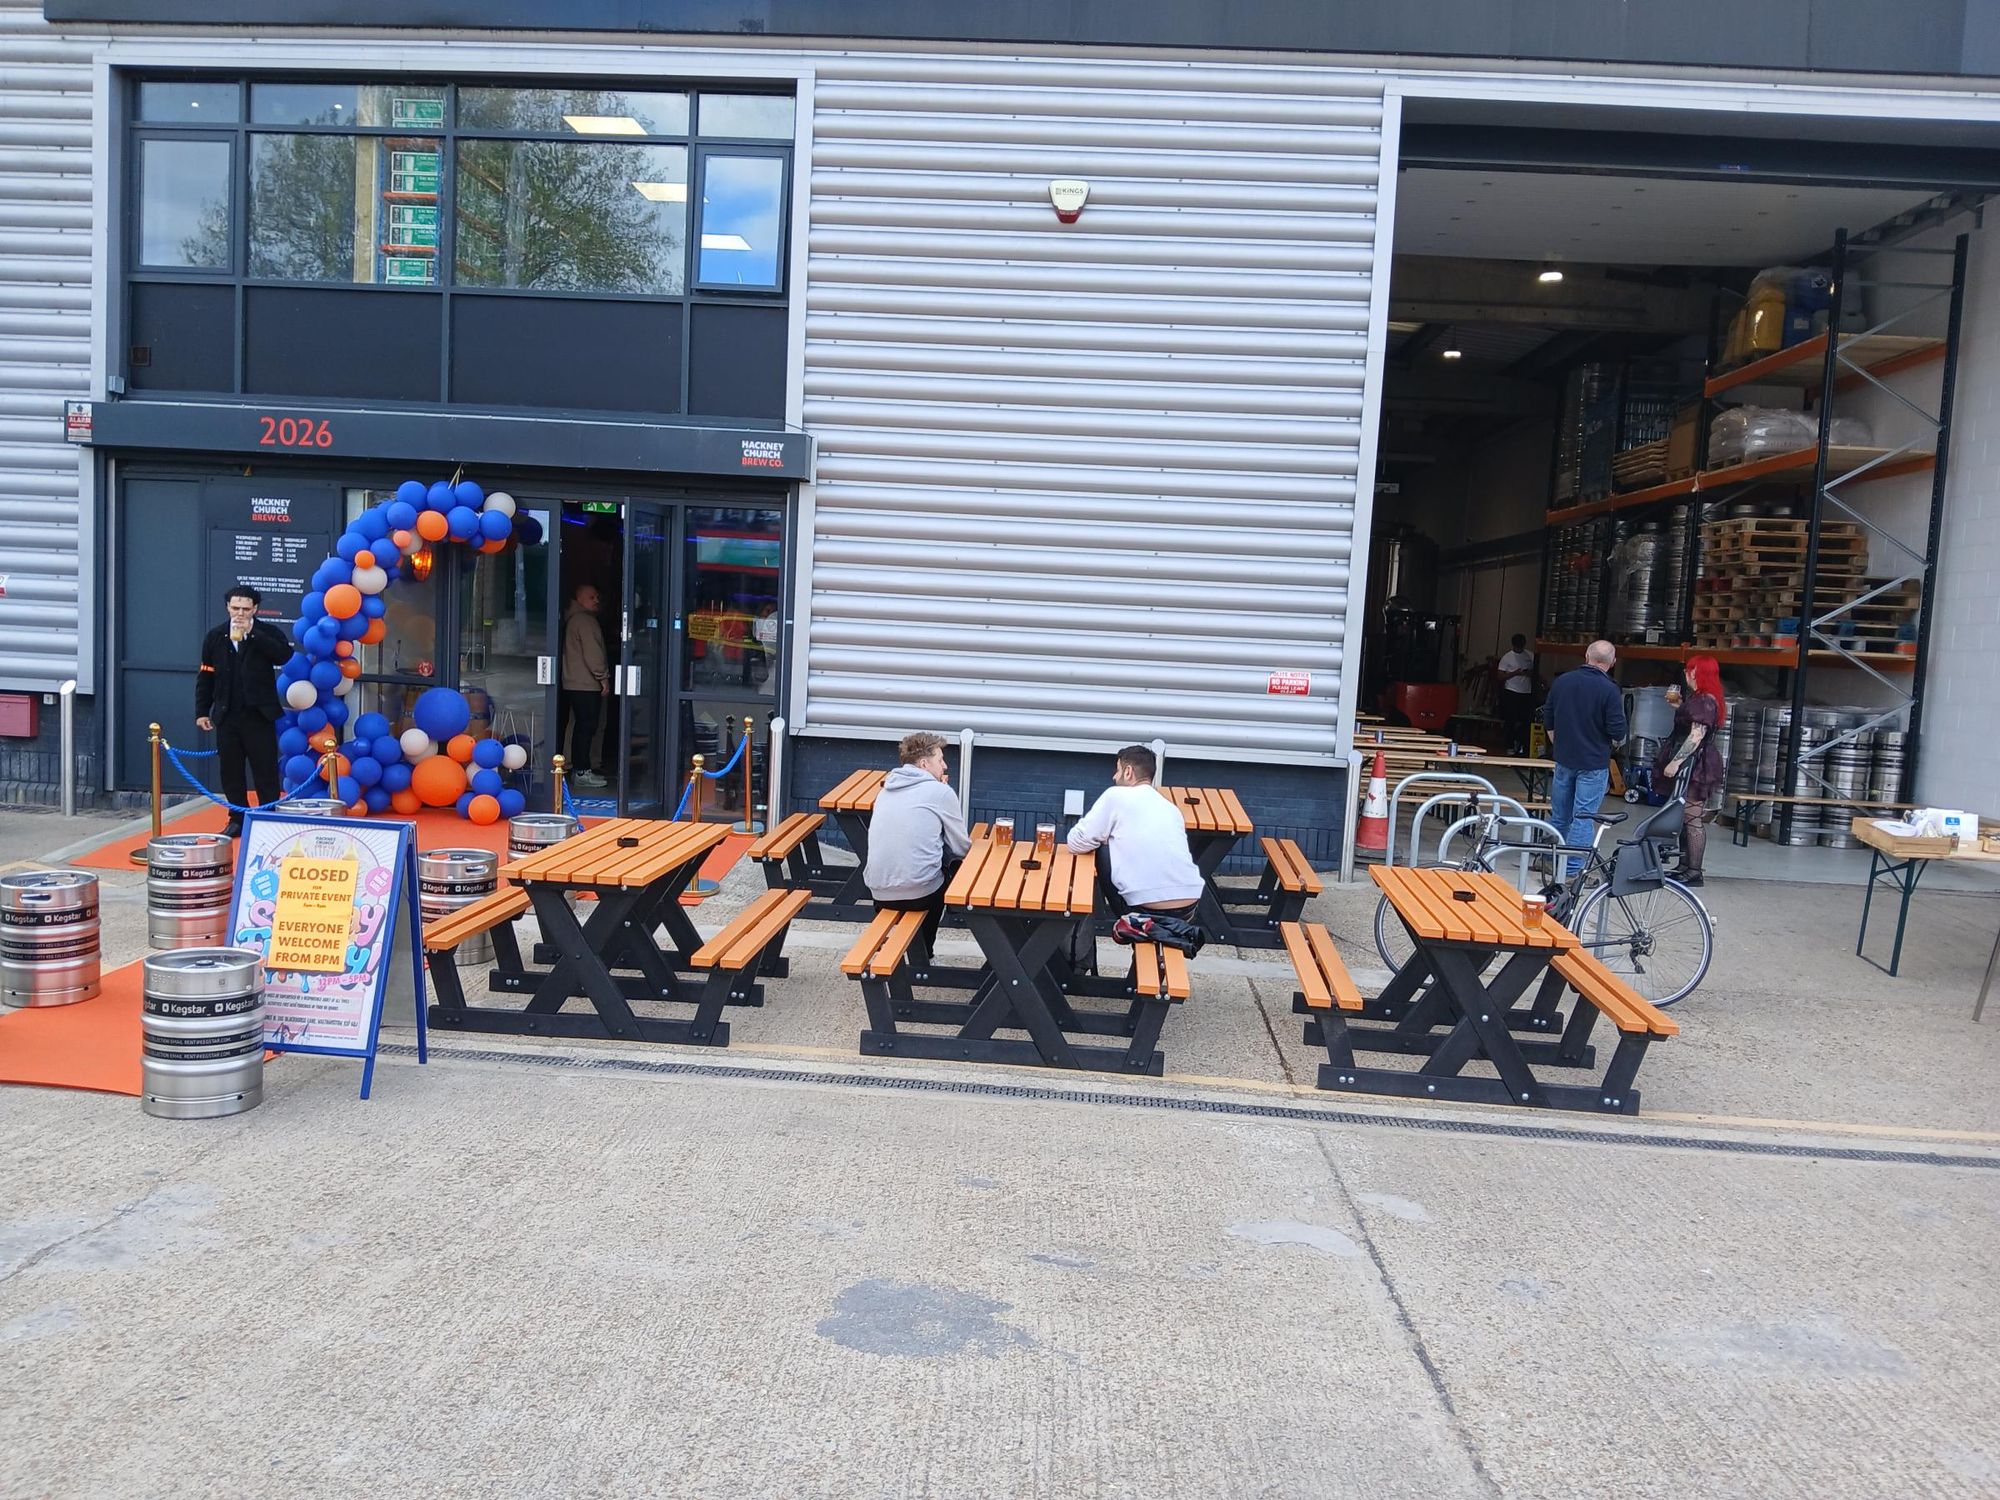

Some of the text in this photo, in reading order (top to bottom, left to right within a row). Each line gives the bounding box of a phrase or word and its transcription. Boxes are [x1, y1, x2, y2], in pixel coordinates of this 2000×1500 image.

[260, 416, 333, 447] 2026
[741, 440, 784, 450] HACKNEY
[743, 449, 781, 458] CHURCH
[742, 457, 784, 467] BREW CO.
[251, 498, 291, 506] HACKNEY
[253, 506, 288, 514] CHURCH
[190, 868, 215, 878] Kegstar
[289, 867, 349, 882] CLOSED
[427, 883, 485, 893] Kegstar Kegstar
[280, 890, 352, 902] PRIVATE EVENT
[10, 912, 82, 924] Kegstar Kegstar
[278, 921, 344, 934] EVERYONE
[278, 936, 340, 950] WELCOME
[275, 952, 340, 965] FROM 8PM
[319, 977, 340, 986] 12PM
[349, 974, 367, 983] 5PM
[170, 1004, 207, 1016] Kegstar
[225, 999, 254, 1012] Kegstar
